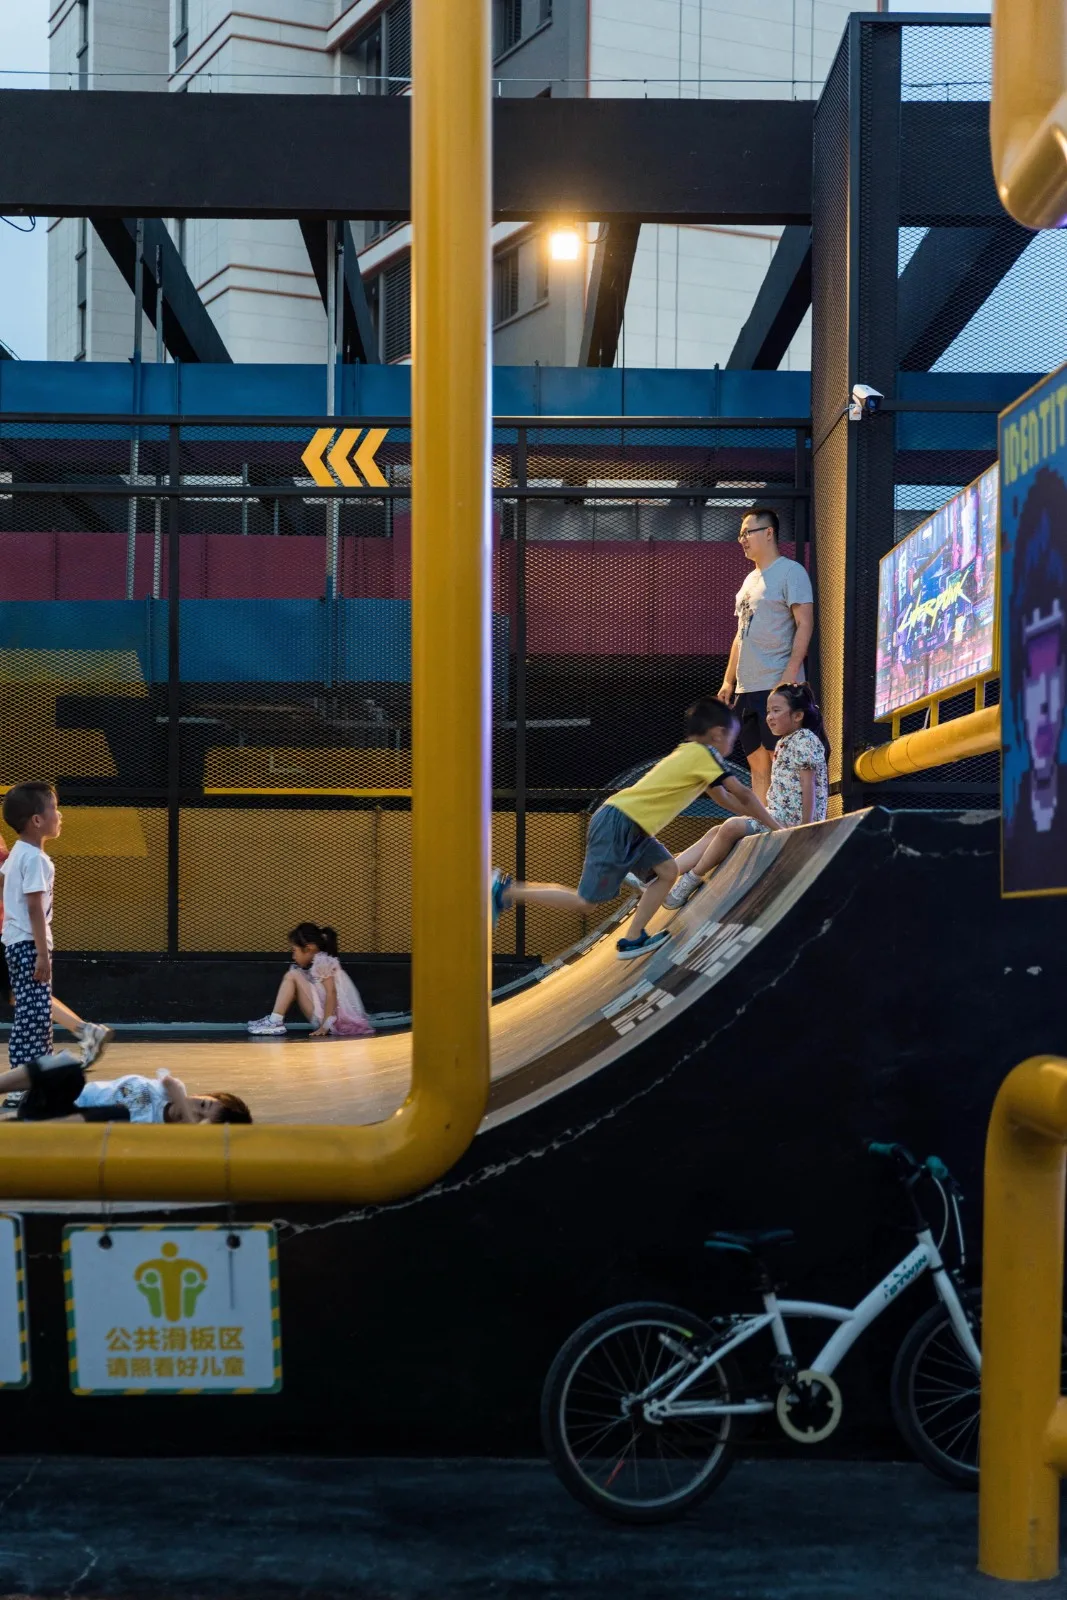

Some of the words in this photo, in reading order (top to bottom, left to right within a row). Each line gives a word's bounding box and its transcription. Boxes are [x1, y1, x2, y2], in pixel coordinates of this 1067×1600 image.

[105, 1326, 244, 1351] 公共滑板区
[106, 1356, 244, 1377] 请照看好儿童
